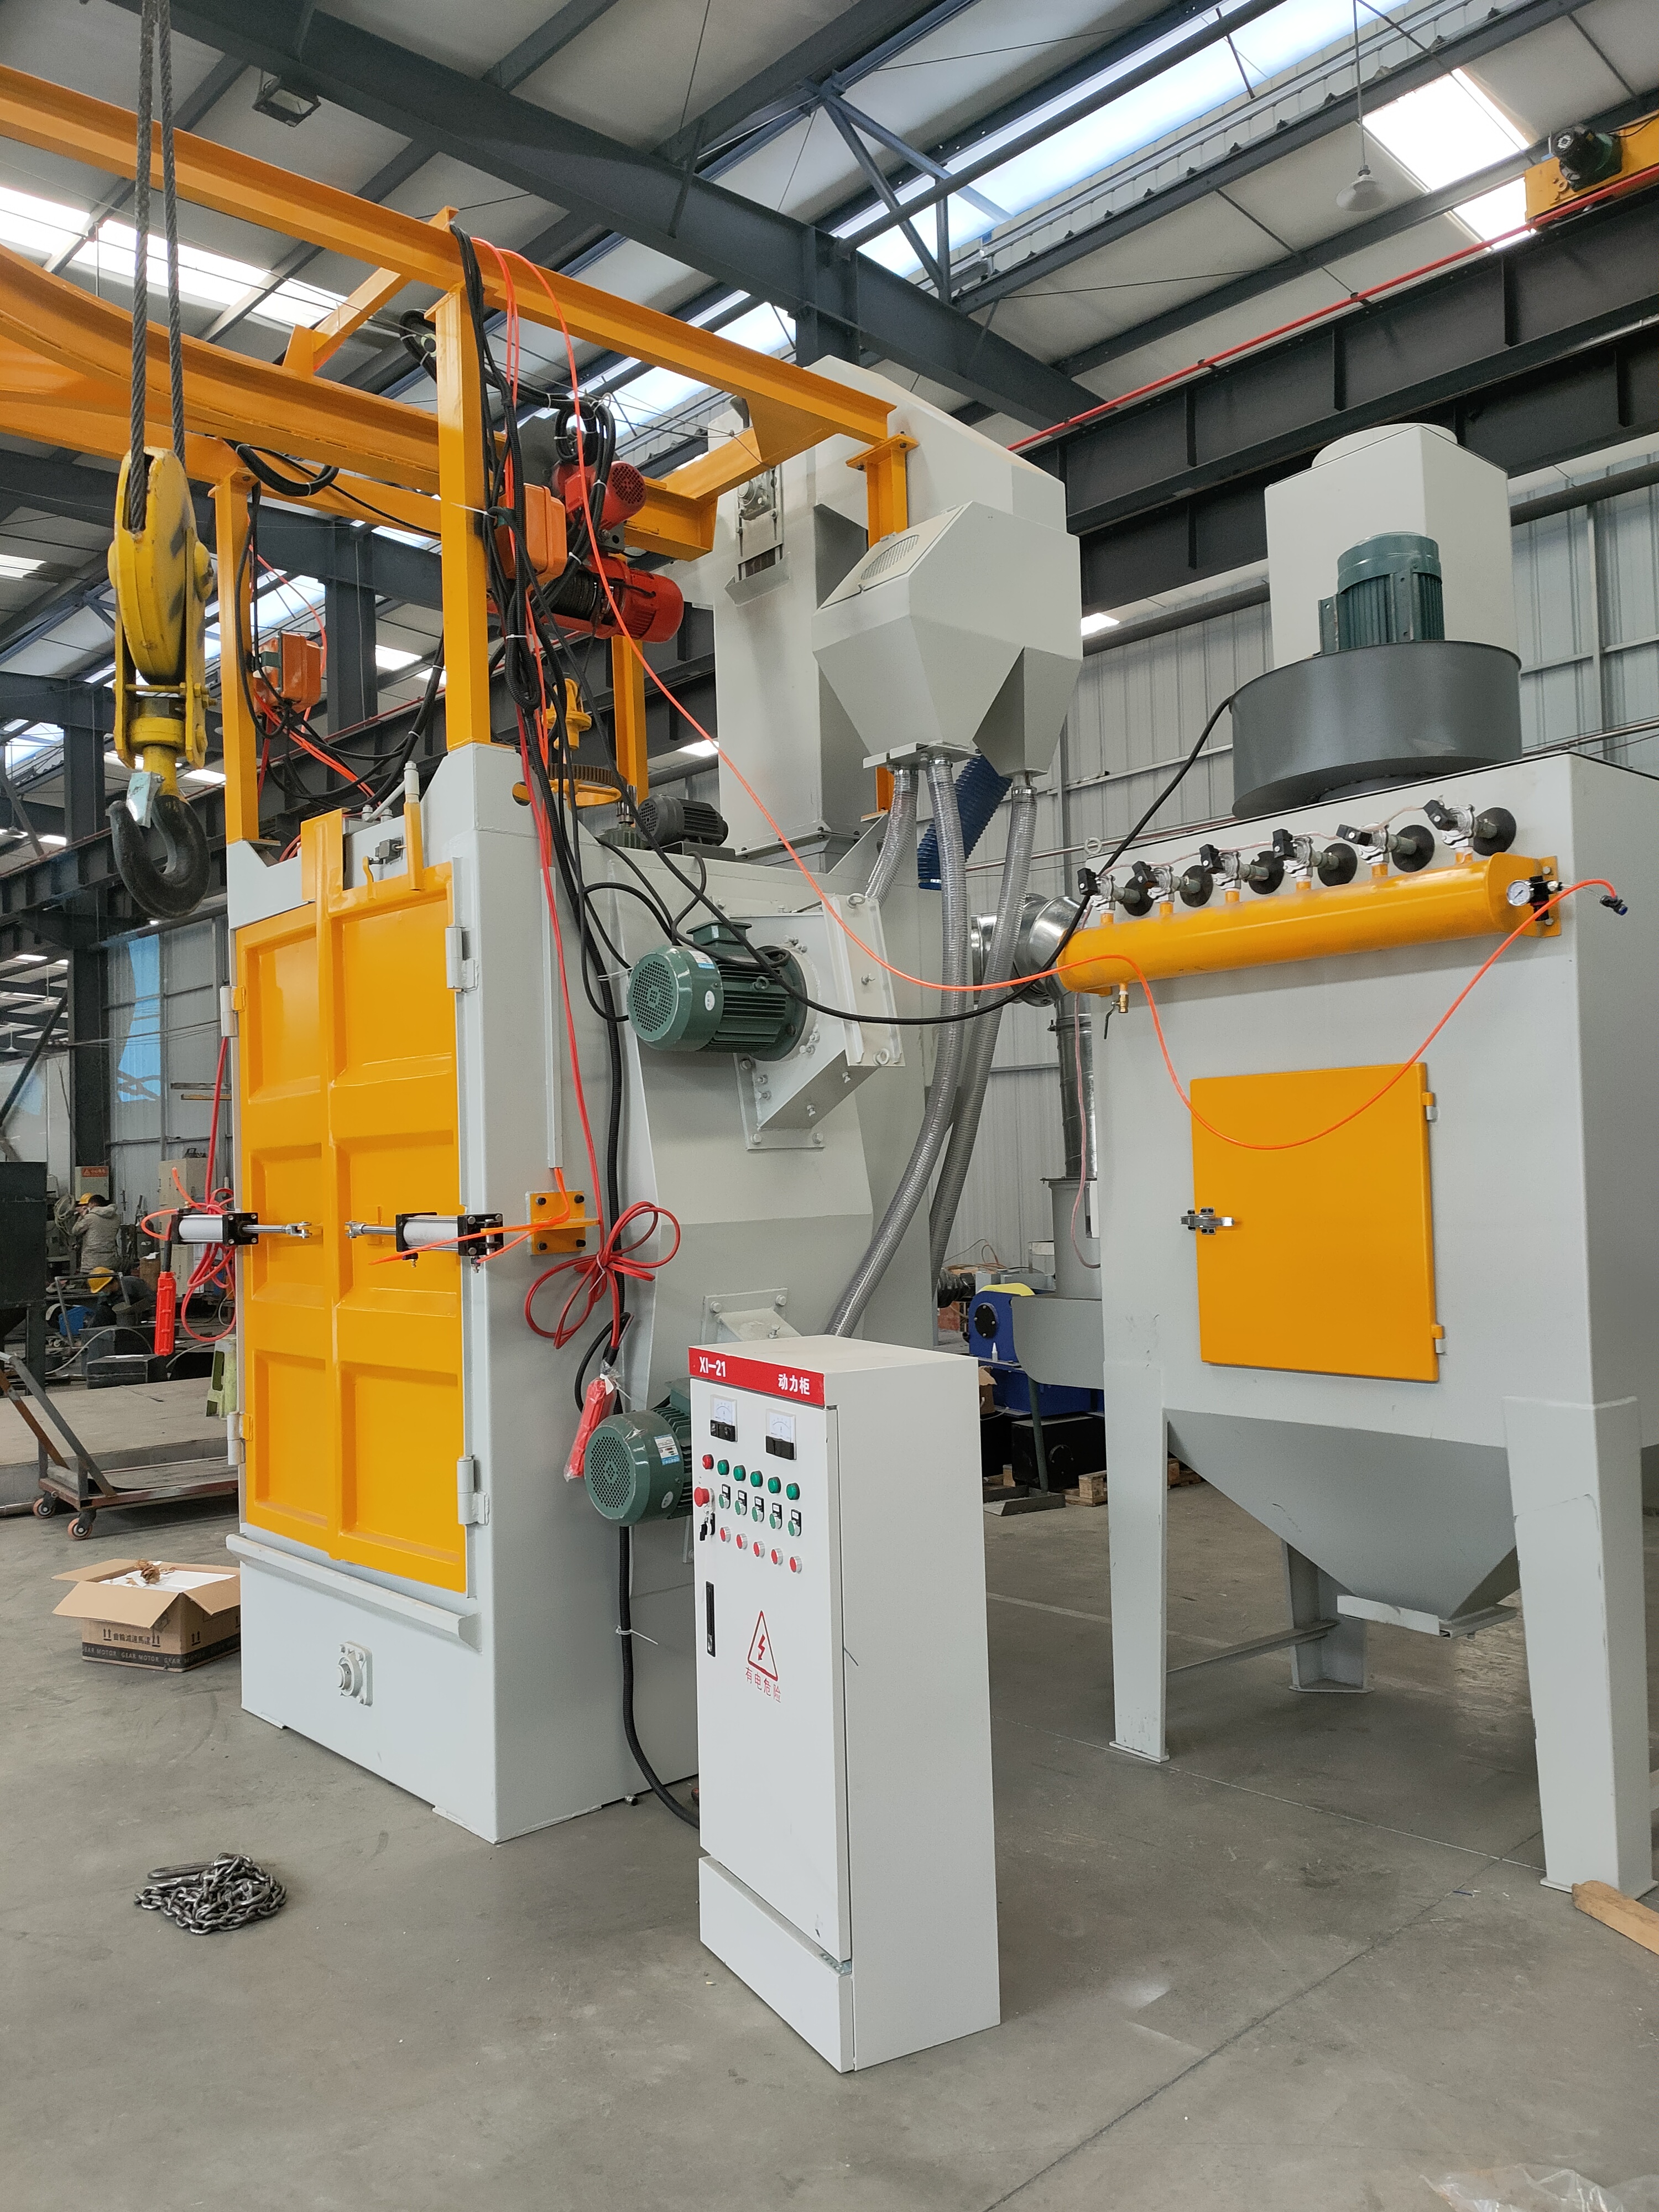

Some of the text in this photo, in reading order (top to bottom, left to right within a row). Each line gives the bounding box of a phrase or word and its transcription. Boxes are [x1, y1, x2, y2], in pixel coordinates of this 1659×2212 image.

[778, 1373, 810, 1395] 动力柜
[138, 1654, 159, 1662] MOTOR
[745, 1666, 781, 1703] 有电危险
